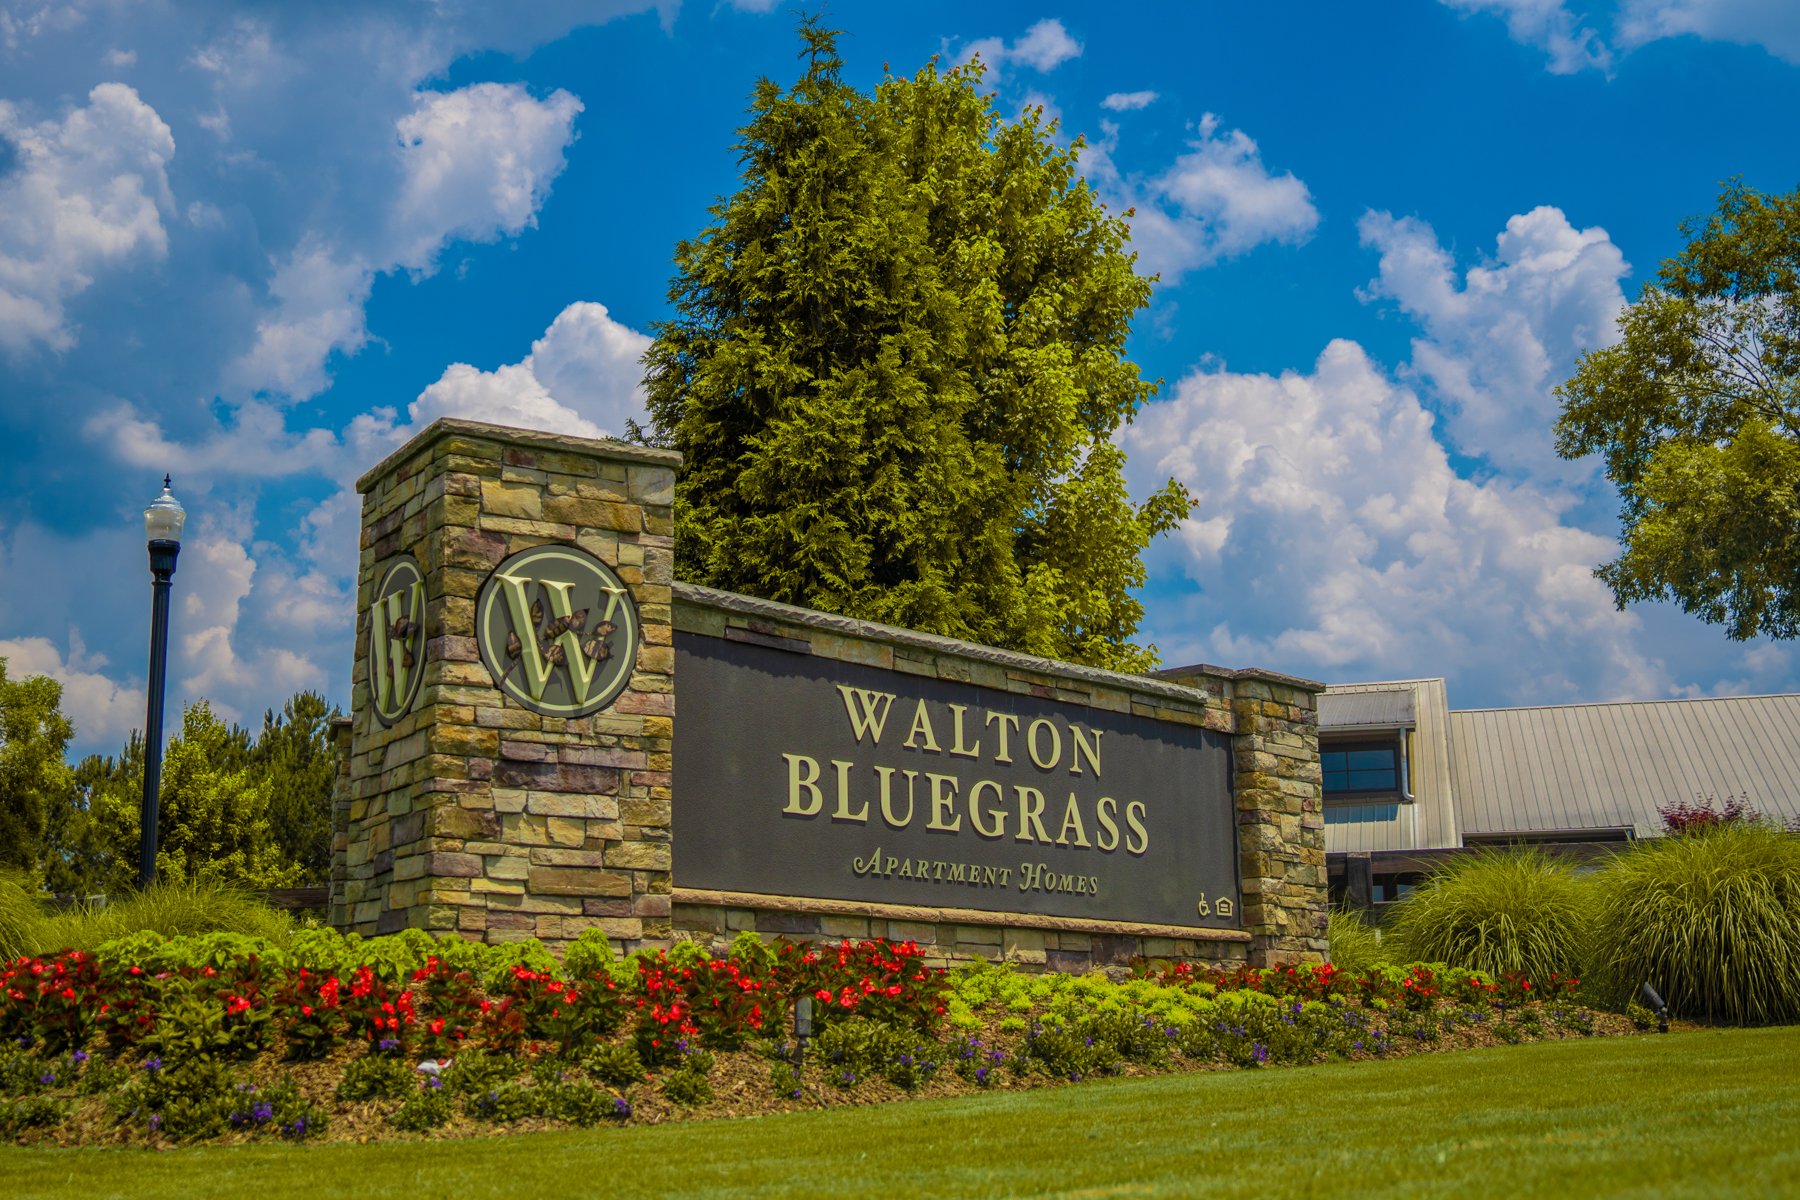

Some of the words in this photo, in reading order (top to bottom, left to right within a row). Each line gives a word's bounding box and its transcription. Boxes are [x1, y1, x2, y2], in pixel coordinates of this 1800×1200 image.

[371, 579, 423, 713] W
[494, 574, 627, 704] W
[836, 684, 1104, 778] WALTON
[782, 752, 1149, 854] BLUEGRASS
[853, 847, 1012, 886] APARTMENT
[1019, 862, 1099, 895] HOMES
